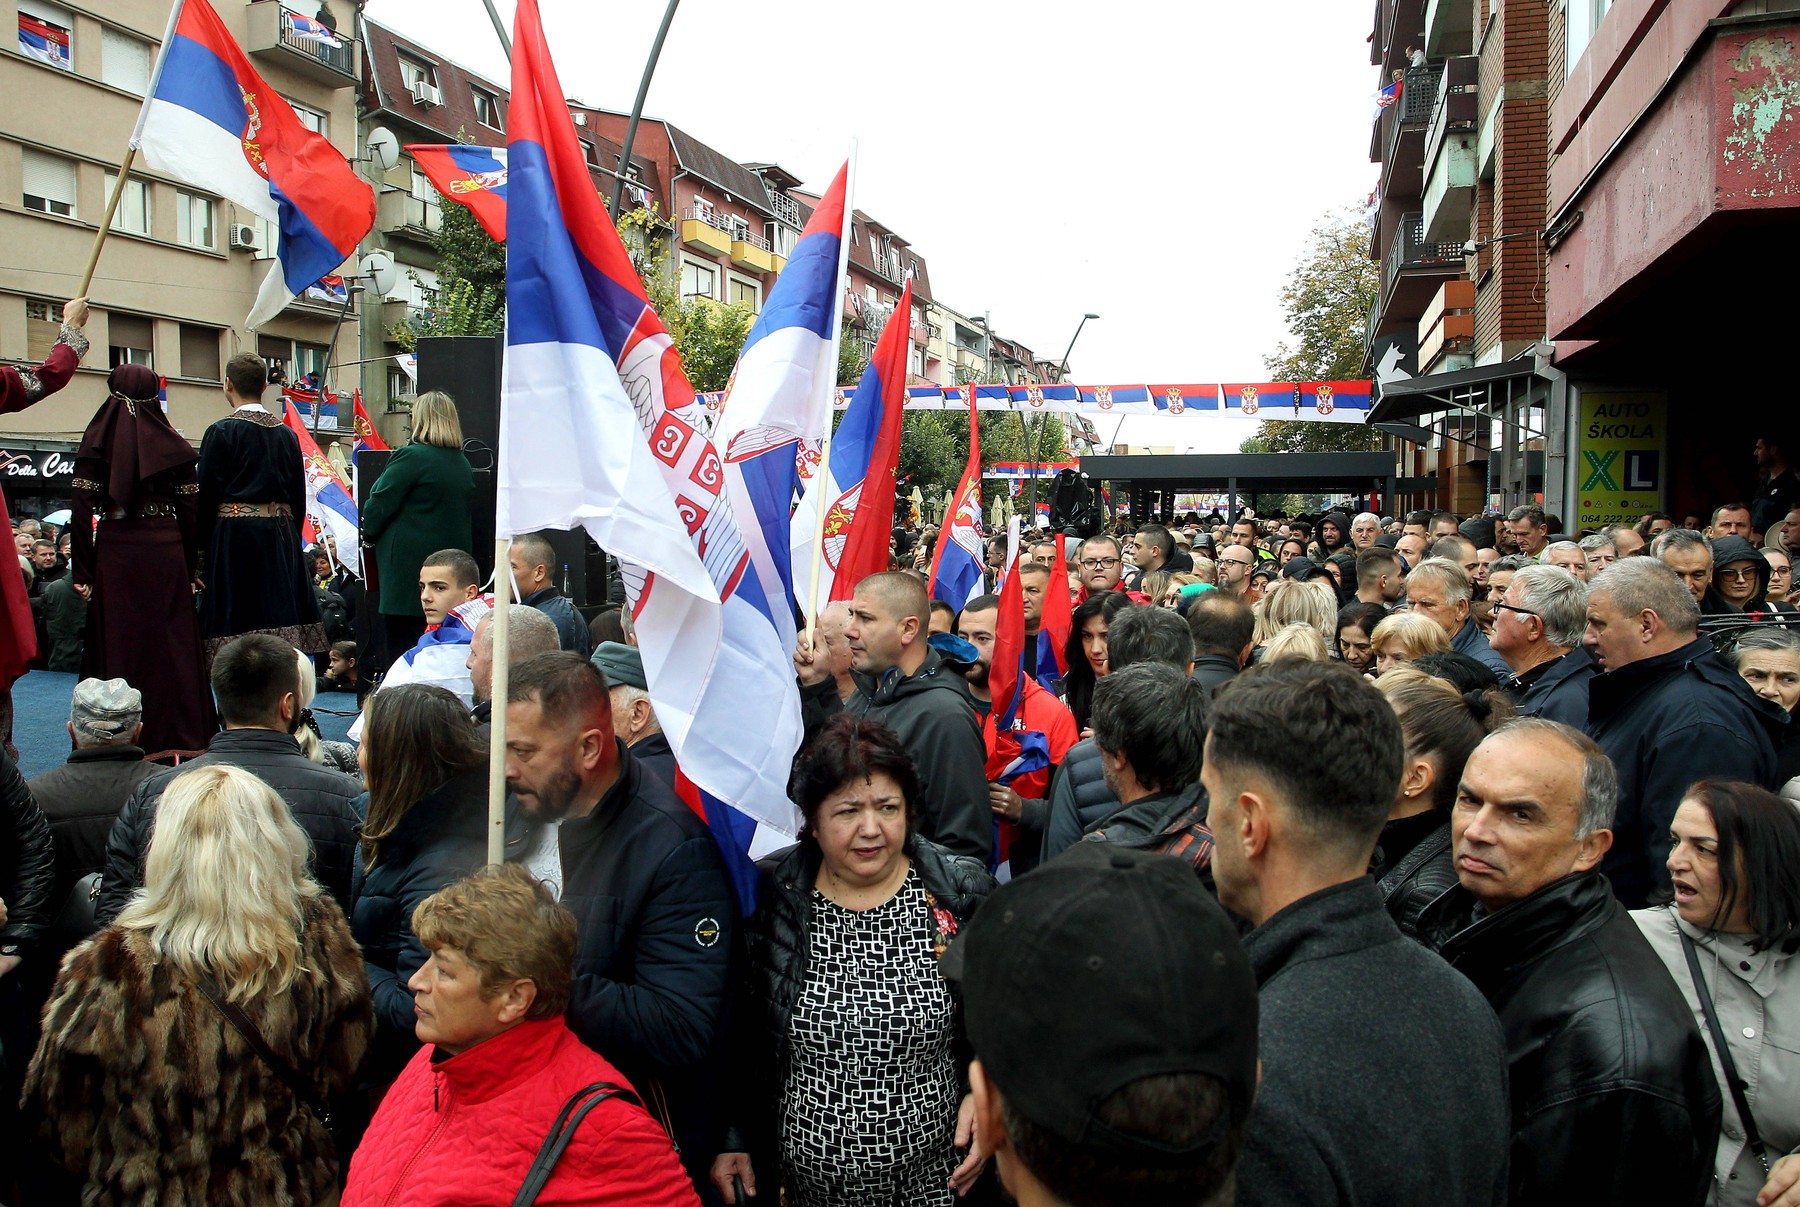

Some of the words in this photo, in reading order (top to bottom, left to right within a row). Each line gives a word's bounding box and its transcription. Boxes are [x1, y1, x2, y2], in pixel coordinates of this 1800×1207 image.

[1593, 403, 1650, 418] AUTO
[1587, 421, 1654, 438] ŠKOLA
[7, 463, 38, 476] Della
[1581, 514, 1600, 523] 064
[1602, 514, 1623, 523] 222
